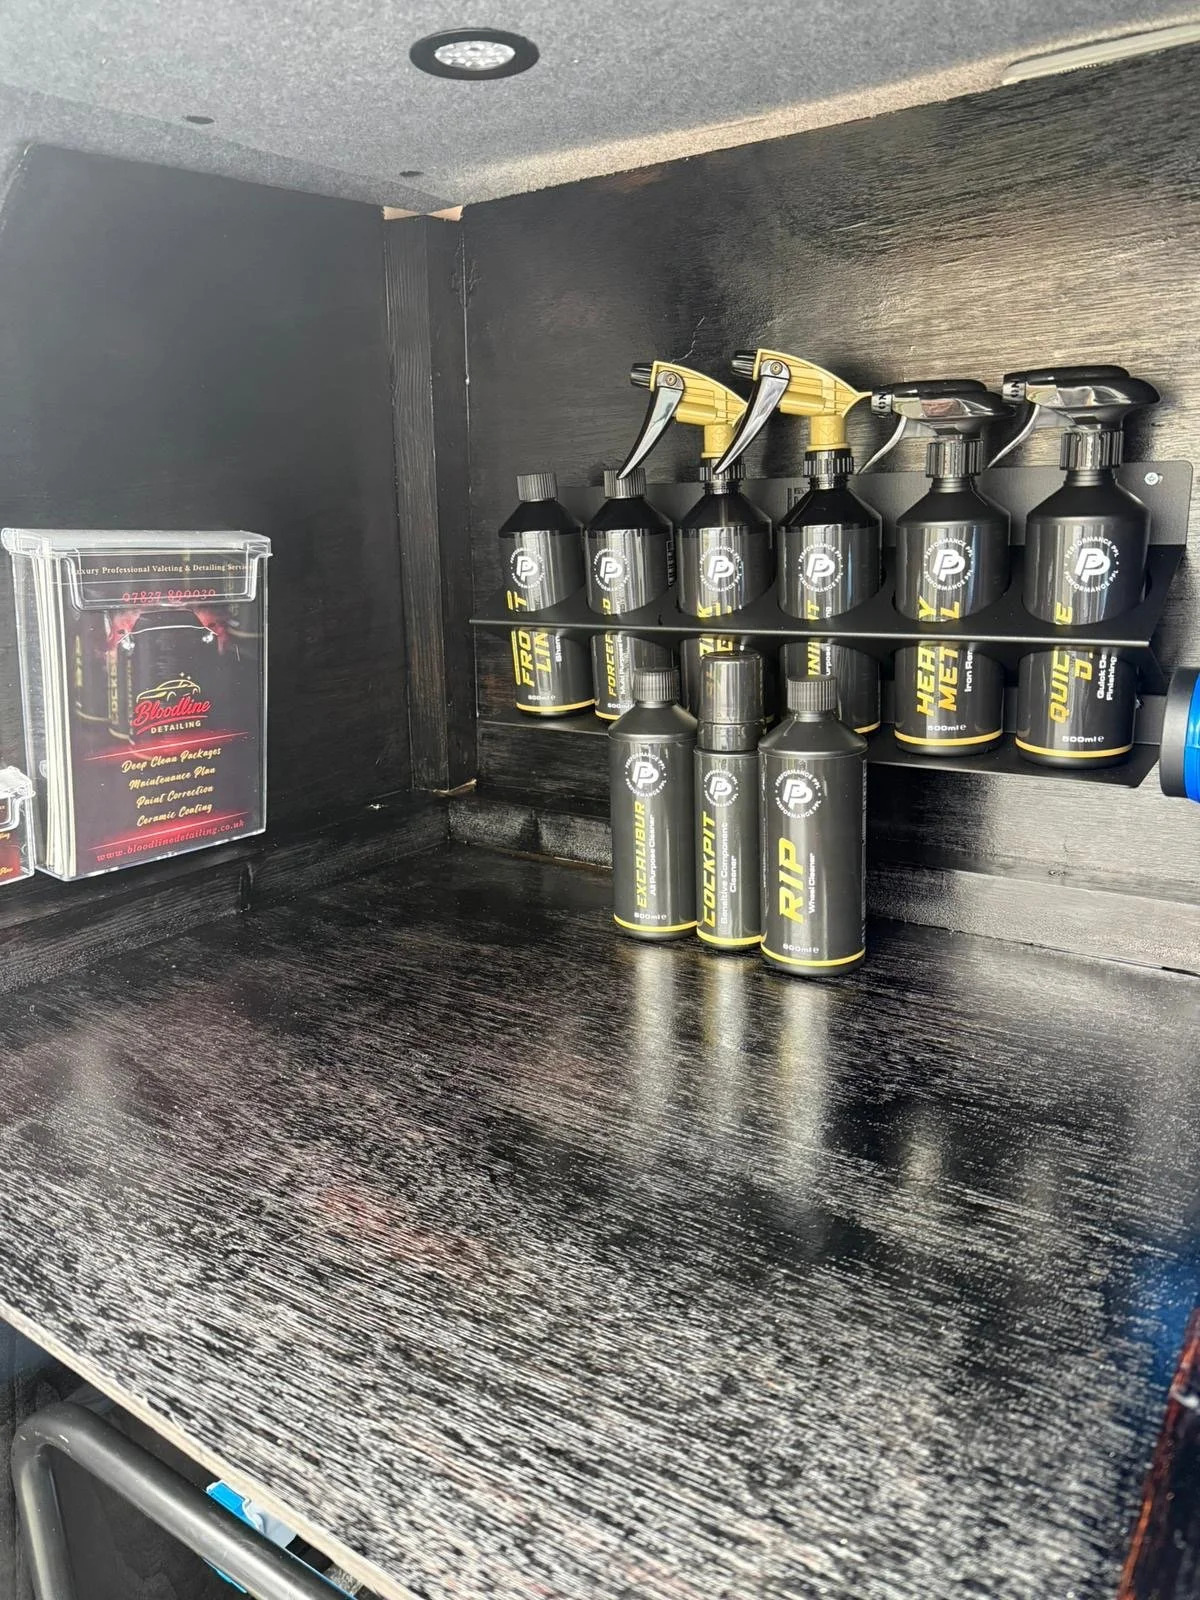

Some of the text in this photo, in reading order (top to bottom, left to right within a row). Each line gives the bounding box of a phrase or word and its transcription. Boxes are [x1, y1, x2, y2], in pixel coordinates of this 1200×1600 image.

[76, 567, 99, 576] uxury
[102, 565, 150, 574] Professional
[152, 564, 183, 573] Valeting
[193, 563, 225, 572] Detailing
[514, 591, 535, 687] FROT
[603, 598, 617, 697] FORCEFD
[917, 595, 936, 717] HEAY
[938, 601, 960, 712] METL
[964, 671, 972, 692] Iron
[1097, 669, 1106, 699] Quick
[1106, 656, 1118, 701] Finishing
[131, 695, 212, 726] Bloodline
[151, 720, 201, 734] DETAILING
[121, 747, 222, 773] Deep Clean Packages
[128, 766, 216, 790] Maintenance Plan
[136, 785, 214, 808] Paint Correction
[136, 803, 213, 827] Ceramic Coating
[96, 819, 245, 862] www.bloodlinedetailing.co.uk
[648, 814, 656, 847] Cleaner
[634, 800, 648, 909] EXCALIBUR
[649, 848, 657, 883] Purpose
[703, 810, 716, 928] COCKPIT
[720, 822, 729, 924] Sensitive Component
[779, 837, 804, 924] RIP
[808, 852, 816, 914] Wheel Cleaner
